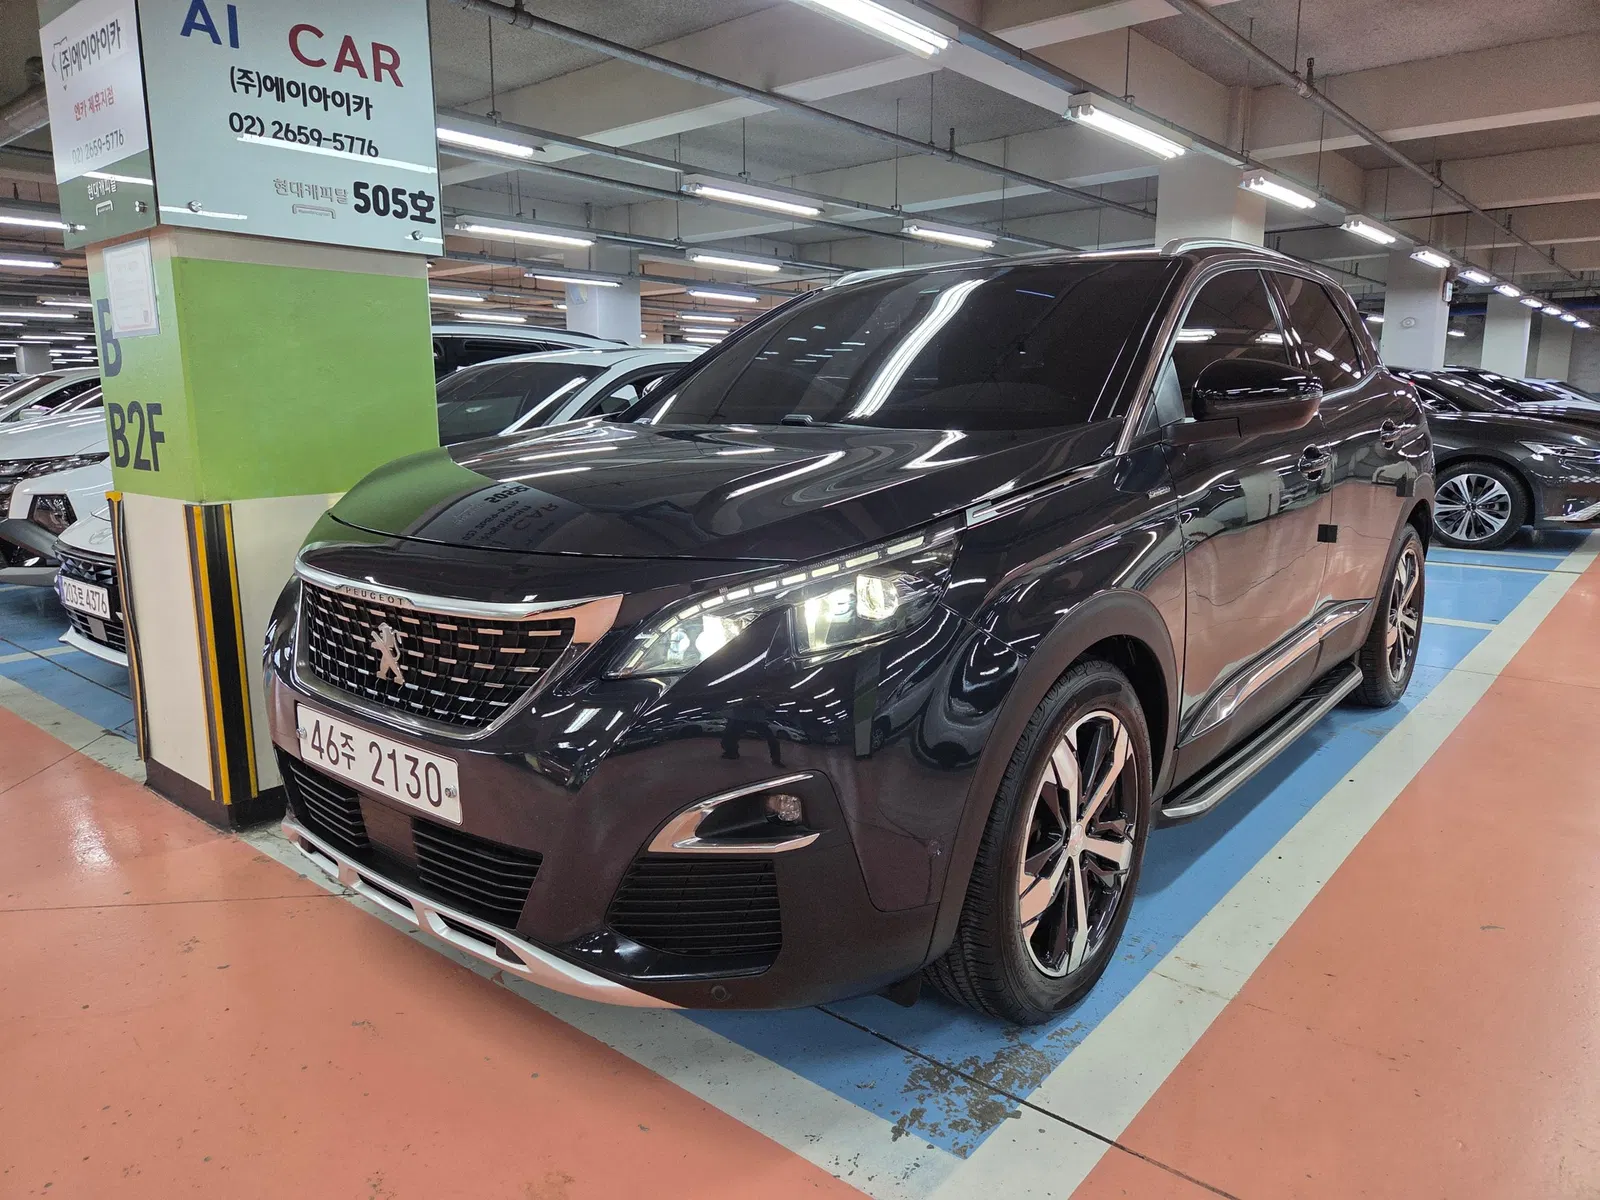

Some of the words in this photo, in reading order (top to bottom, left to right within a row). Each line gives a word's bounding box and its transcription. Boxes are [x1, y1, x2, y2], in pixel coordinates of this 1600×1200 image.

[59, 18, 121, 81] (주)에이아이카
[180, 0, 240, 49] AI
[288, 23, 404, 88] CAR
[230, 66, 373, 121] (주)에이아이카
[85, 128, 125, 160] 2659-5776
[228, 112, 265, 138] 02)
[271, 120, 379, 158] 2659-5776
[273, 178, 348, 205] 현대캐피탈
[353, 181, 437, 224] 505호
[108, 401, 165, 472] B2F
[86, 588, 108, 615] 4376
[345, 586, 404, 606] PEUGEOT
[311, 719, 356, 770] 46주
[368, 740, 443, 808] 2130
